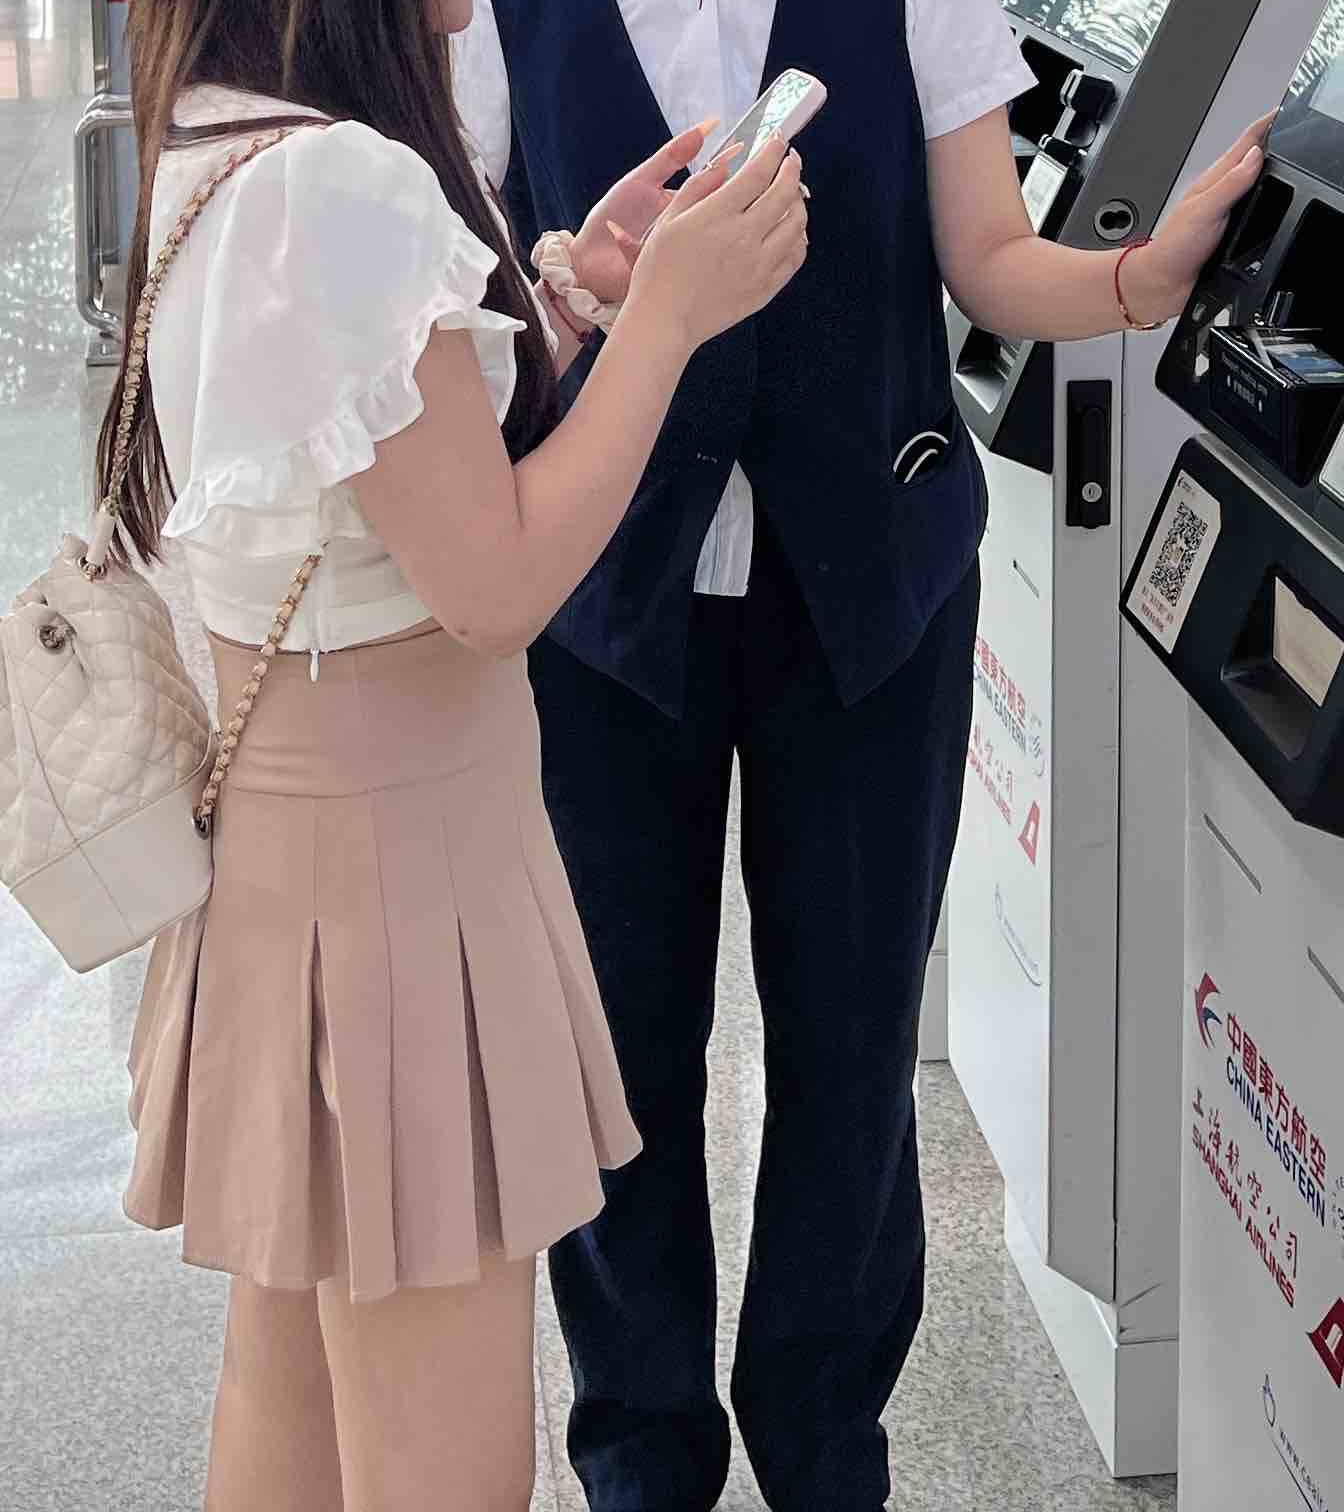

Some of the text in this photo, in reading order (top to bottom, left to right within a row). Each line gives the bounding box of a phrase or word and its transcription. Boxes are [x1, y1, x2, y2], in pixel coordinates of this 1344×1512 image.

[1225, 1055, 1326, 1227] CHINA EASTERN
[1226, 1012, 1326, 1192] 中國東方航空
[1192, 1123, 1295, 1308] SHANGHAI AIRLINES
